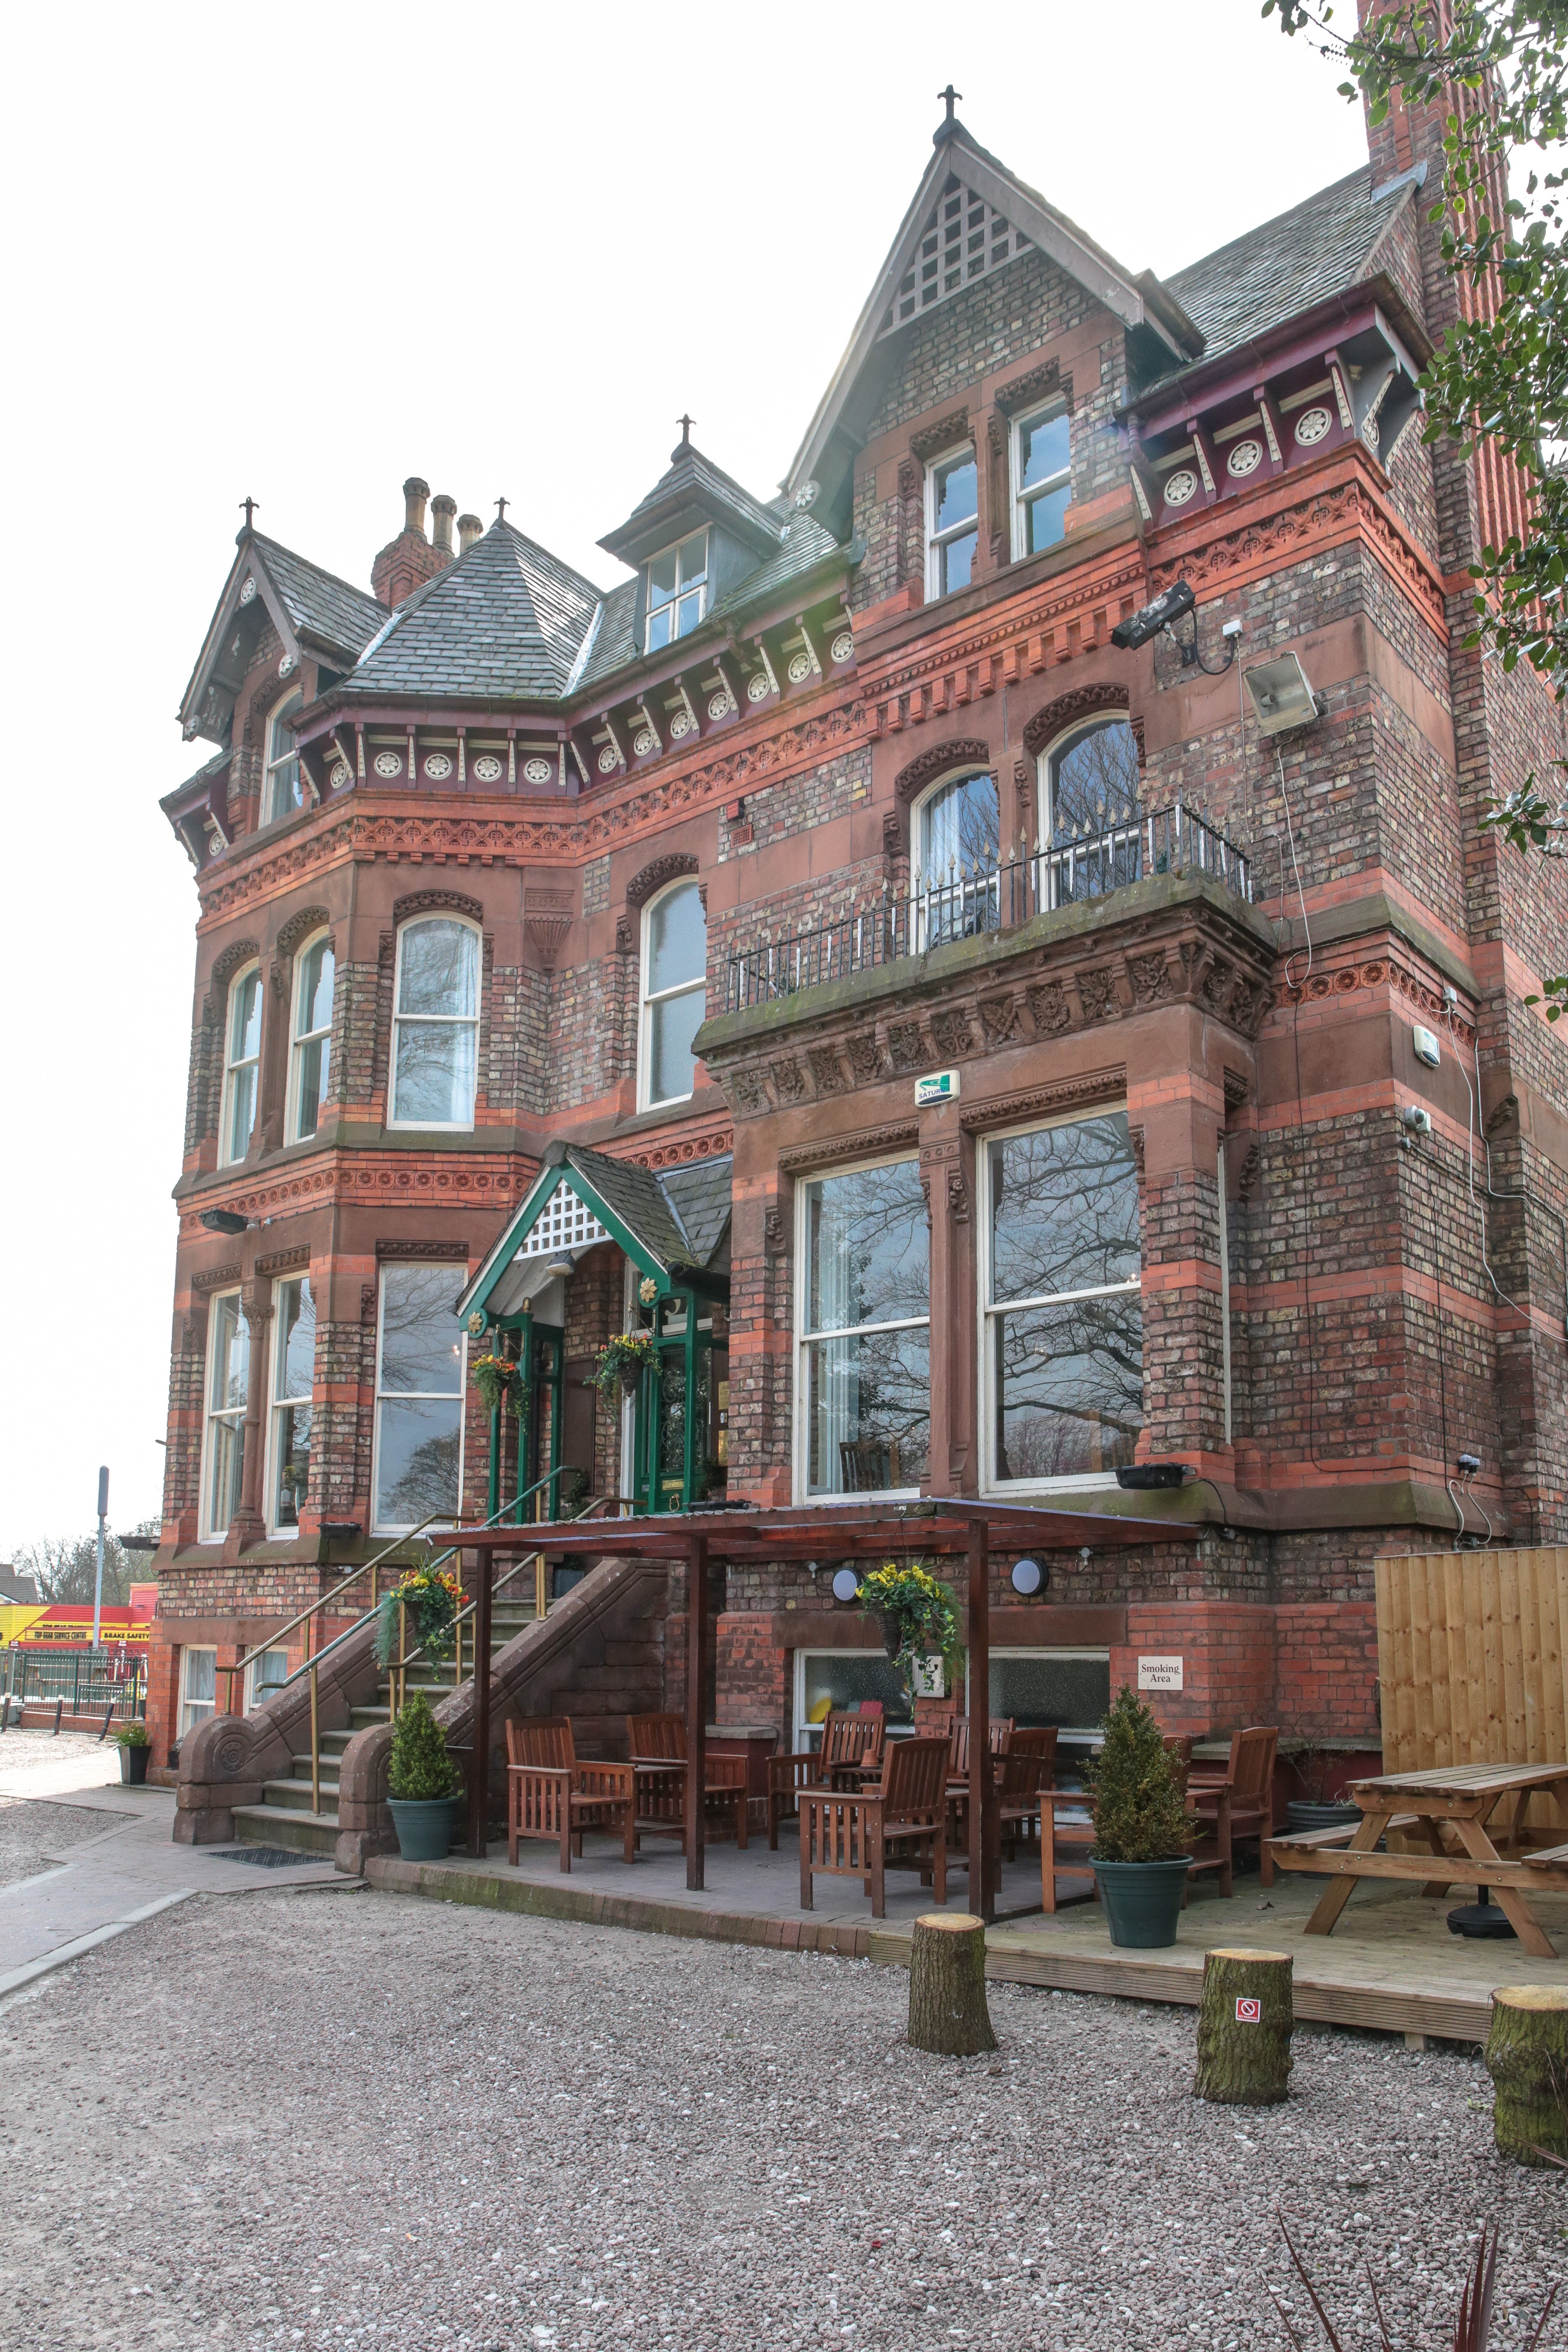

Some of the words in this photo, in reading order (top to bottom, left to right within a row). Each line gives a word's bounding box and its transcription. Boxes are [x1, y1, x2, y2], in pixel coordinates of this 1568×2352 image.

[919, 1087, 945, 1099] SATURN
[1142, 1664, 1179, 1675] Smoking
[1149, 1674, 1171, 1682] Area
